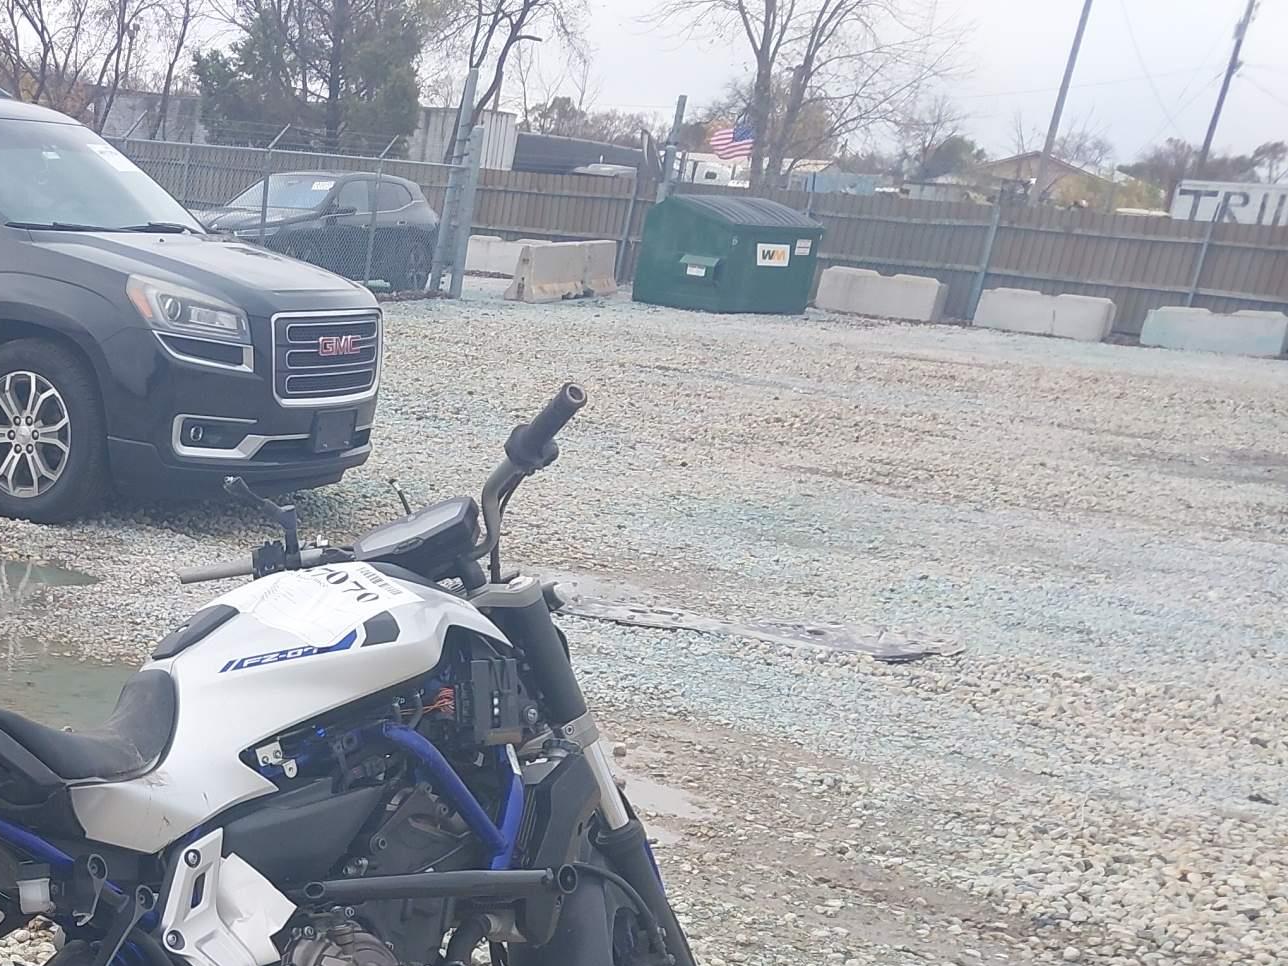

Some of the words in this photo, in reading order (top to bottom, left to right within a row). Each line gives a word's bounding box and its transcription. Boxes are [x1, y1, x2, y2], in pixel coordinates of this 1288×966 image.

[761, 249, 786, 261] WM
[318, 335, 361, 356] GMC
[242, 646, 319, 668] FZ-07
